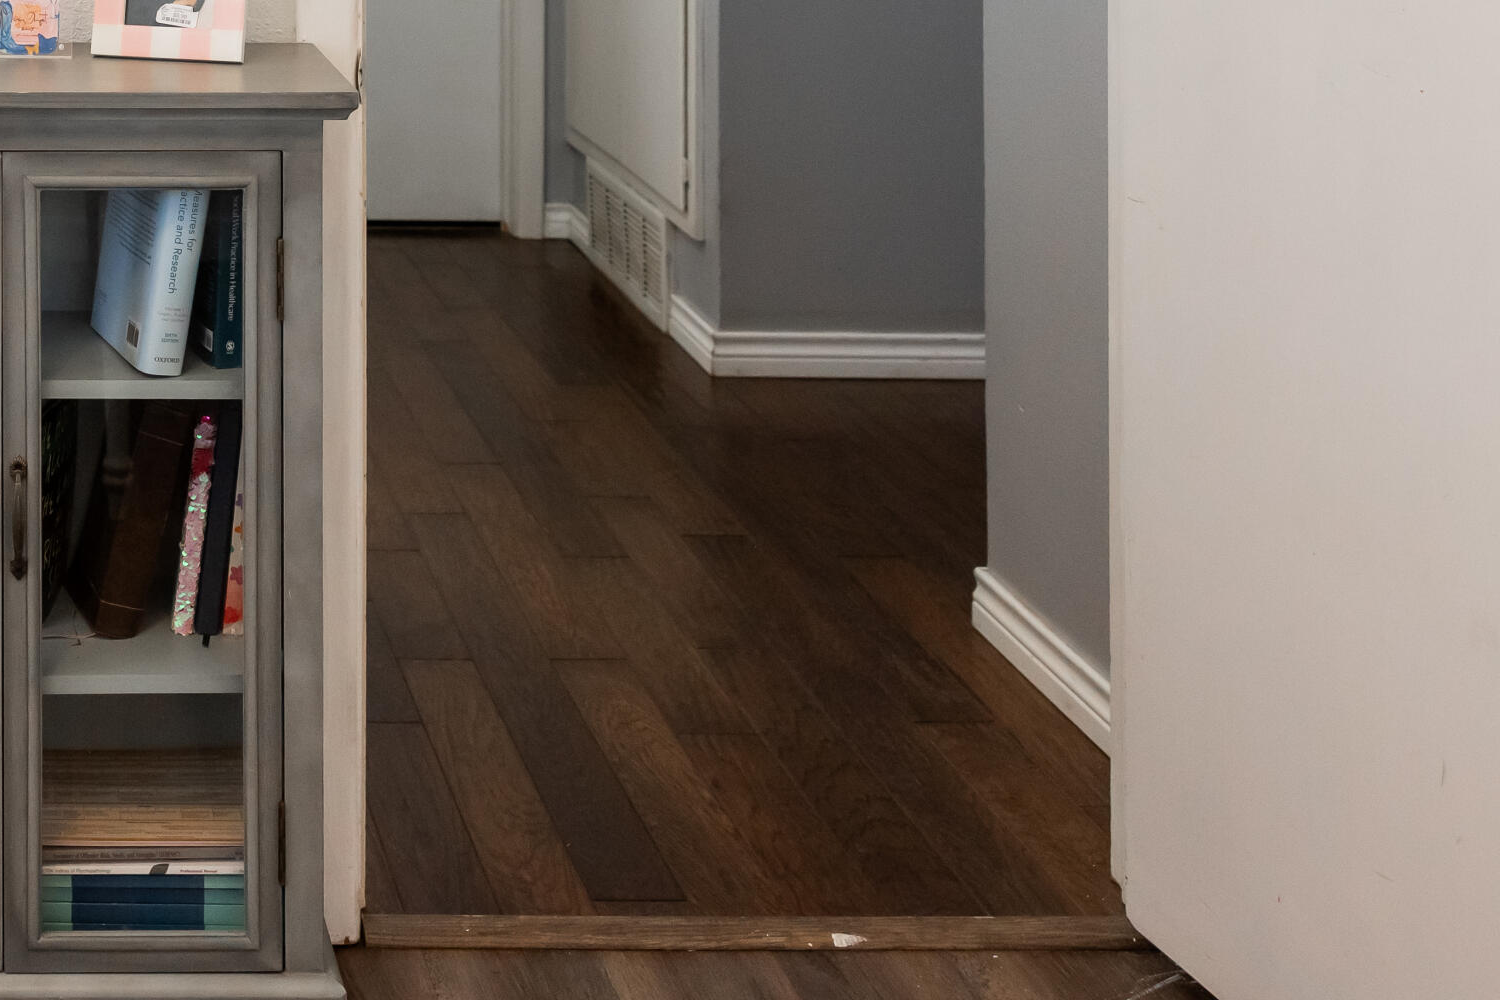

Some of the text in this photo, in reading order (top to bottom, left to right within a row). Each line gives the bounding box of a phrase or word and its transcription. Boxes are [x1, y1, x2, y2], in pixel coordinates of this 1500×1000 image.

[167, 191, 189, 294] actice and Research
[186, 238, 197, 252] for
[228, 241, 239, 271] Practice
[228, 272, 237, 280] in
[227, 281, 237, 322] Healthcare
[154, 356, 181, 364] OXFORD
